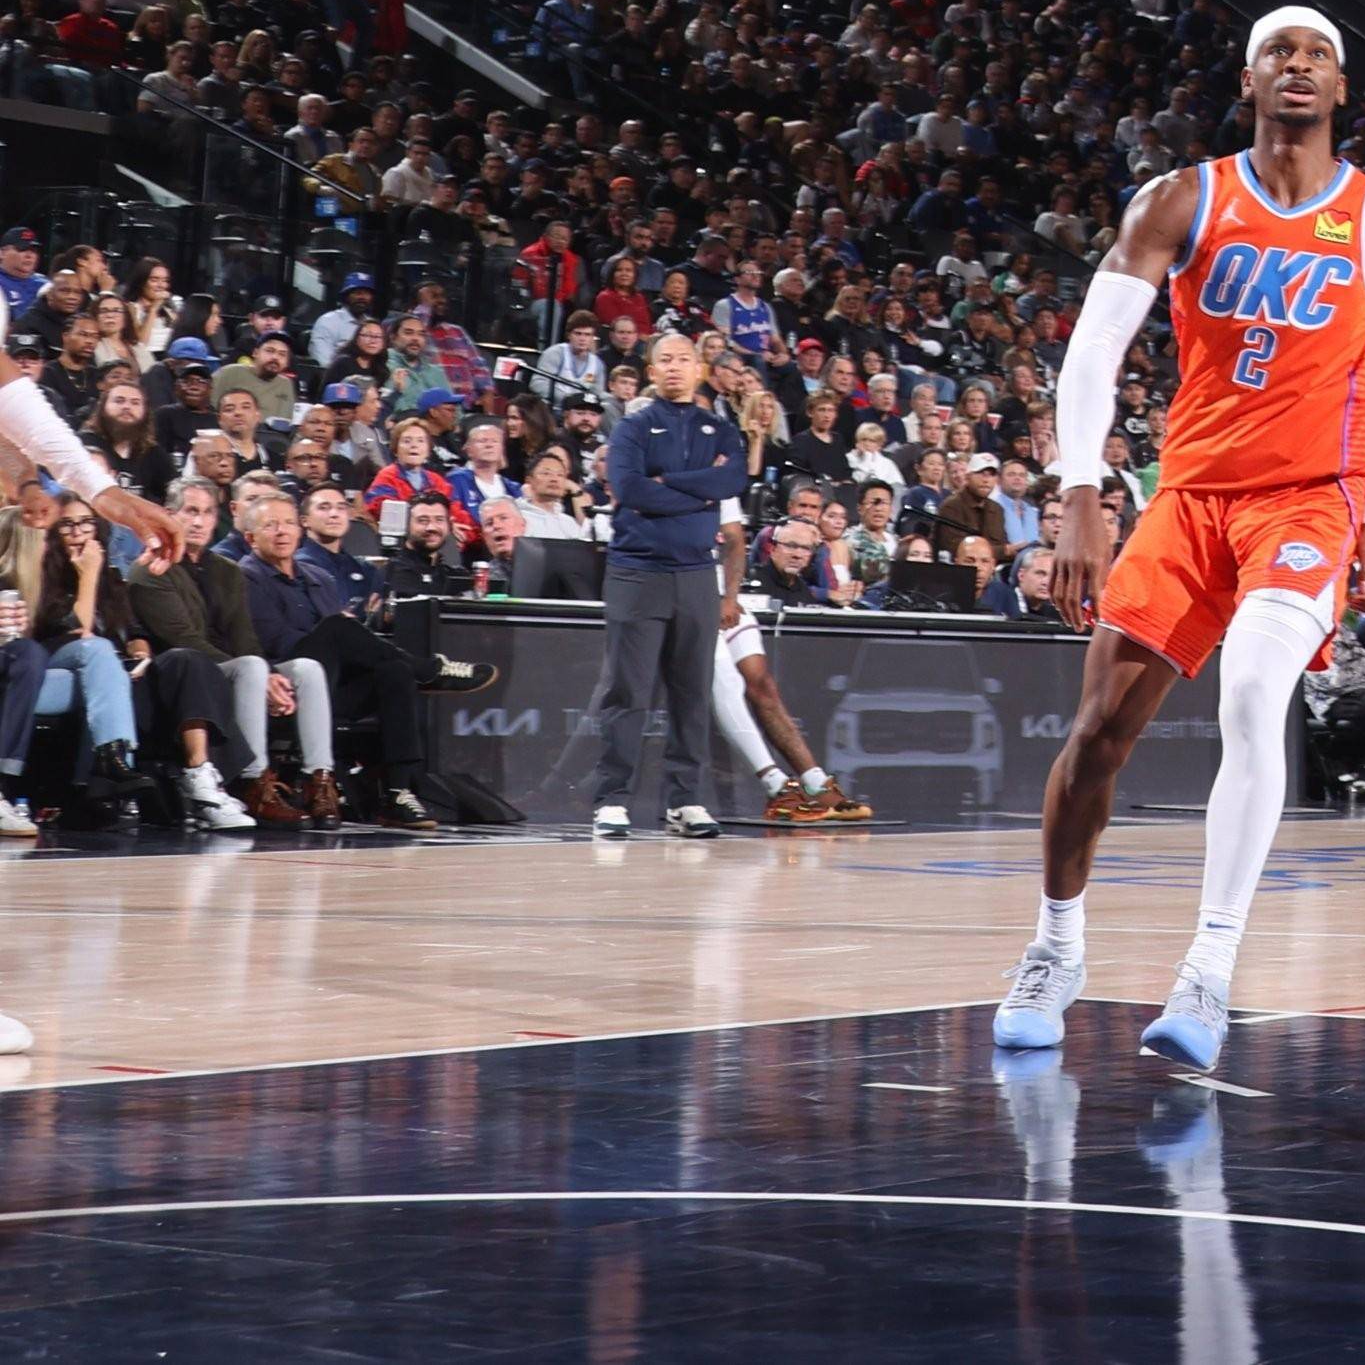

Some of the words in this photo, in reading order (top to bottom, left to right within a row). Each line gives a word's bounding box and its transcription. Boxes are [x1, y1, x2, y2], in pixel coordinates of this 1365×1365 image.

[1199, 242, 1355, 331] OKC
[1232, 325, 1279, 391] 2
[1021, 714, 1075, 738] KI
